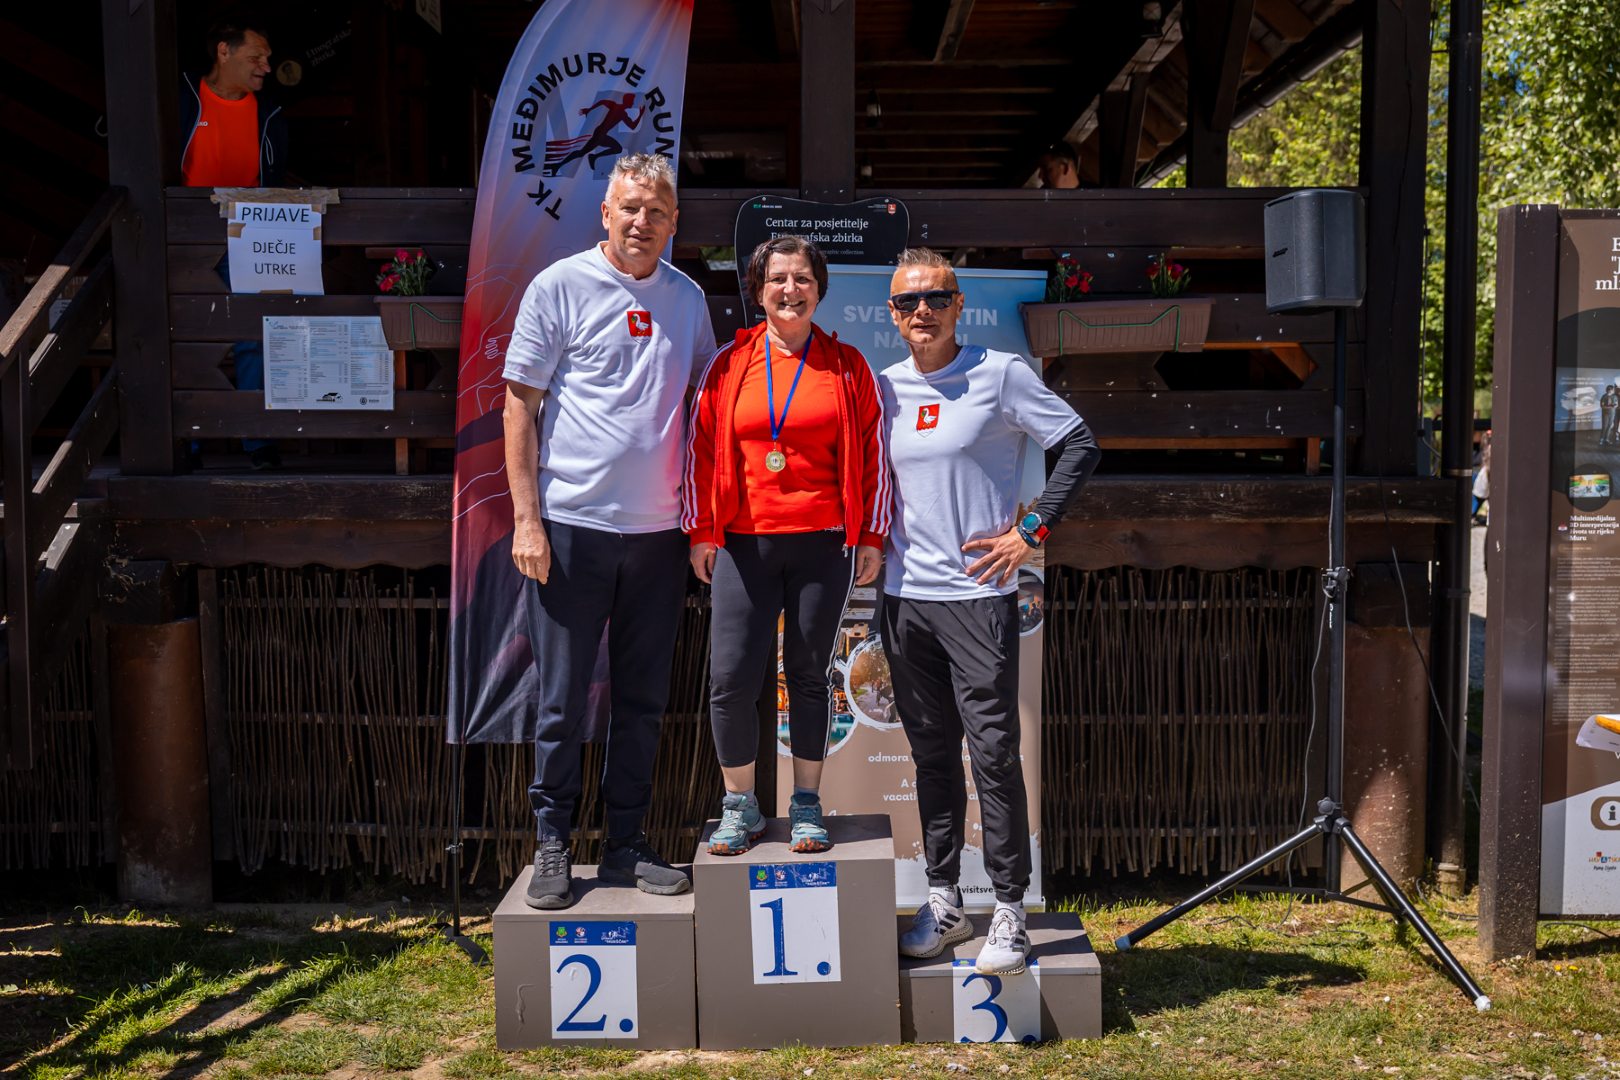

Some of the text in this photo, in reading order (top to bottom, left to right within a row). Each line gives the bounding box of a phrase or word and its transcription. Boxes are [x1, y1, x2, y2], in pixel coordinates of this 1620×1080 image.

[512, 52, 676, 221] TK MEĐIMURJE RUN
[241, 206, 310, 223] PRIJAVE
[765, 217, 869, 230] Centar za posjetitelje
[832, 232, 864, 243] zbirka
[252, 239, 297, 255] DJEČJE
[254, 262, 297, 276] UTRKE
[843, 305, 892, 323] SVE
[868, 752, 909, 762] odmora
[883, 792, 918, 801] vacati
[759, 897, 832, 976] 1.
[556, 953, 634, 1033] 2.
[960, 972, 1037, 1043] 3.
